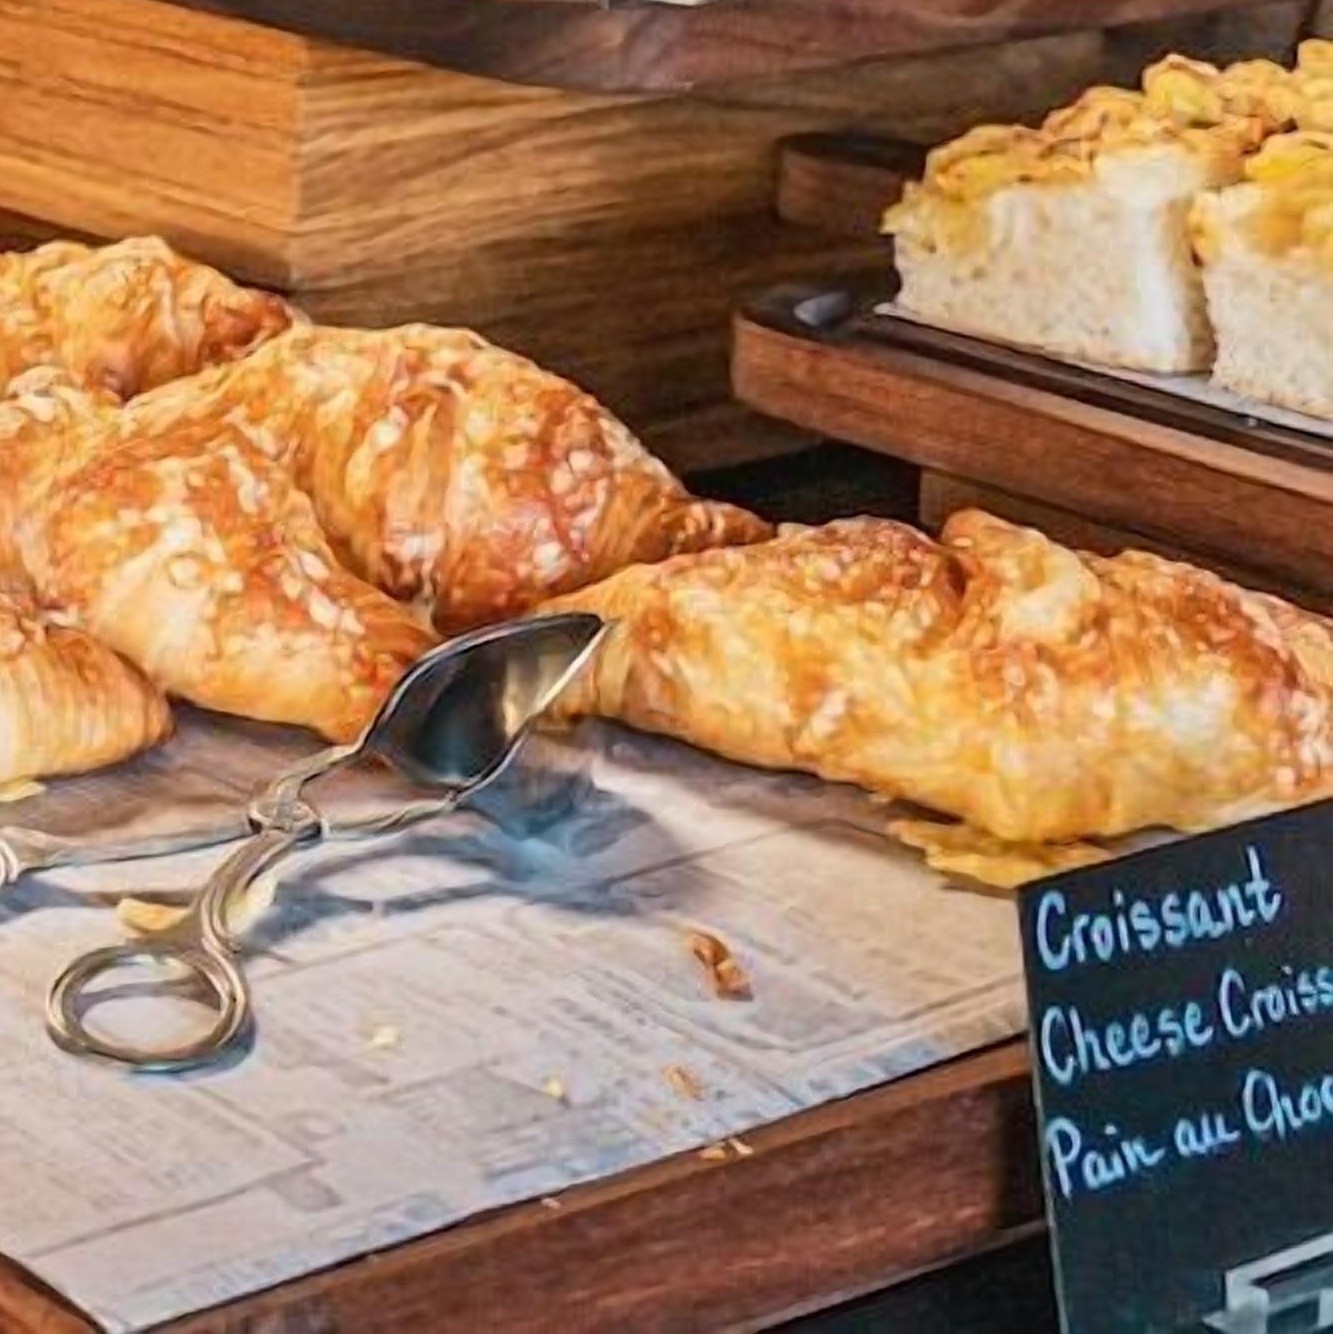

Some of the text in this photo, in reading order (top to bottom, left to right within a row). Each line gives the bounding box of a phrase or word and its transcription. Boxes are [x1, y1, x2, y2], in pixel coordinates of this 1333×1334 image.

[1036, 846, 1282, 970] Croissant
[1040, 1004, 1214, 1086] Cheese
[1044, 1117, 1165, 1199] Pain
[1174, 1113, 1241, 1159] au
